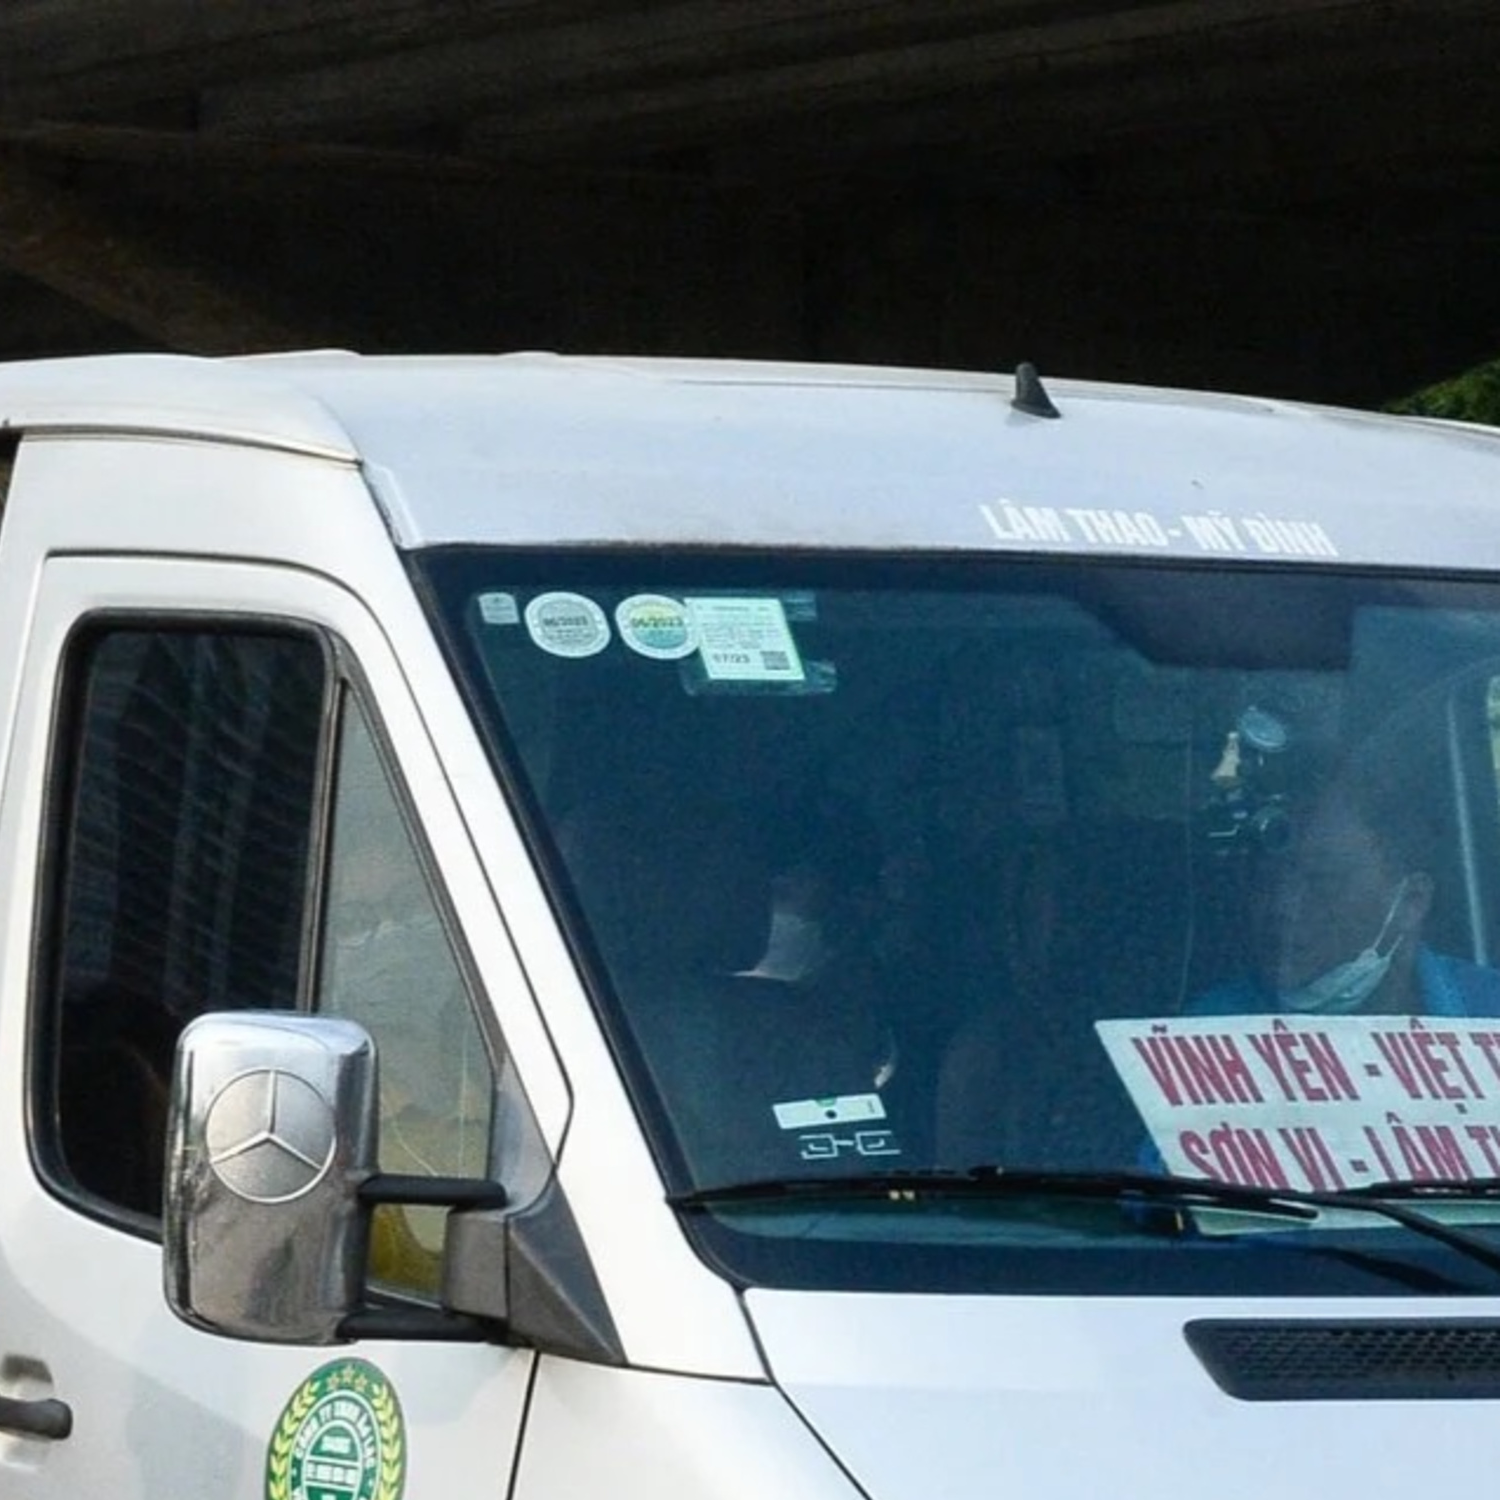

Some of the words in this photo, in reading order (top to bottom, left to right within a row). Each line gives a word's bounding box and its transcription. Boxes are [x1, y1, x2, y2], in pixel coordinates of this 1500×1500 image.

[1131, 1023, 1264, 1107] VĨNH
[1246, 1018, 1361, 1102] YÊN
[1370, 1017, 1486, 1115] VIỆT
[1179, 1121, 1292, 1189] SƠN
